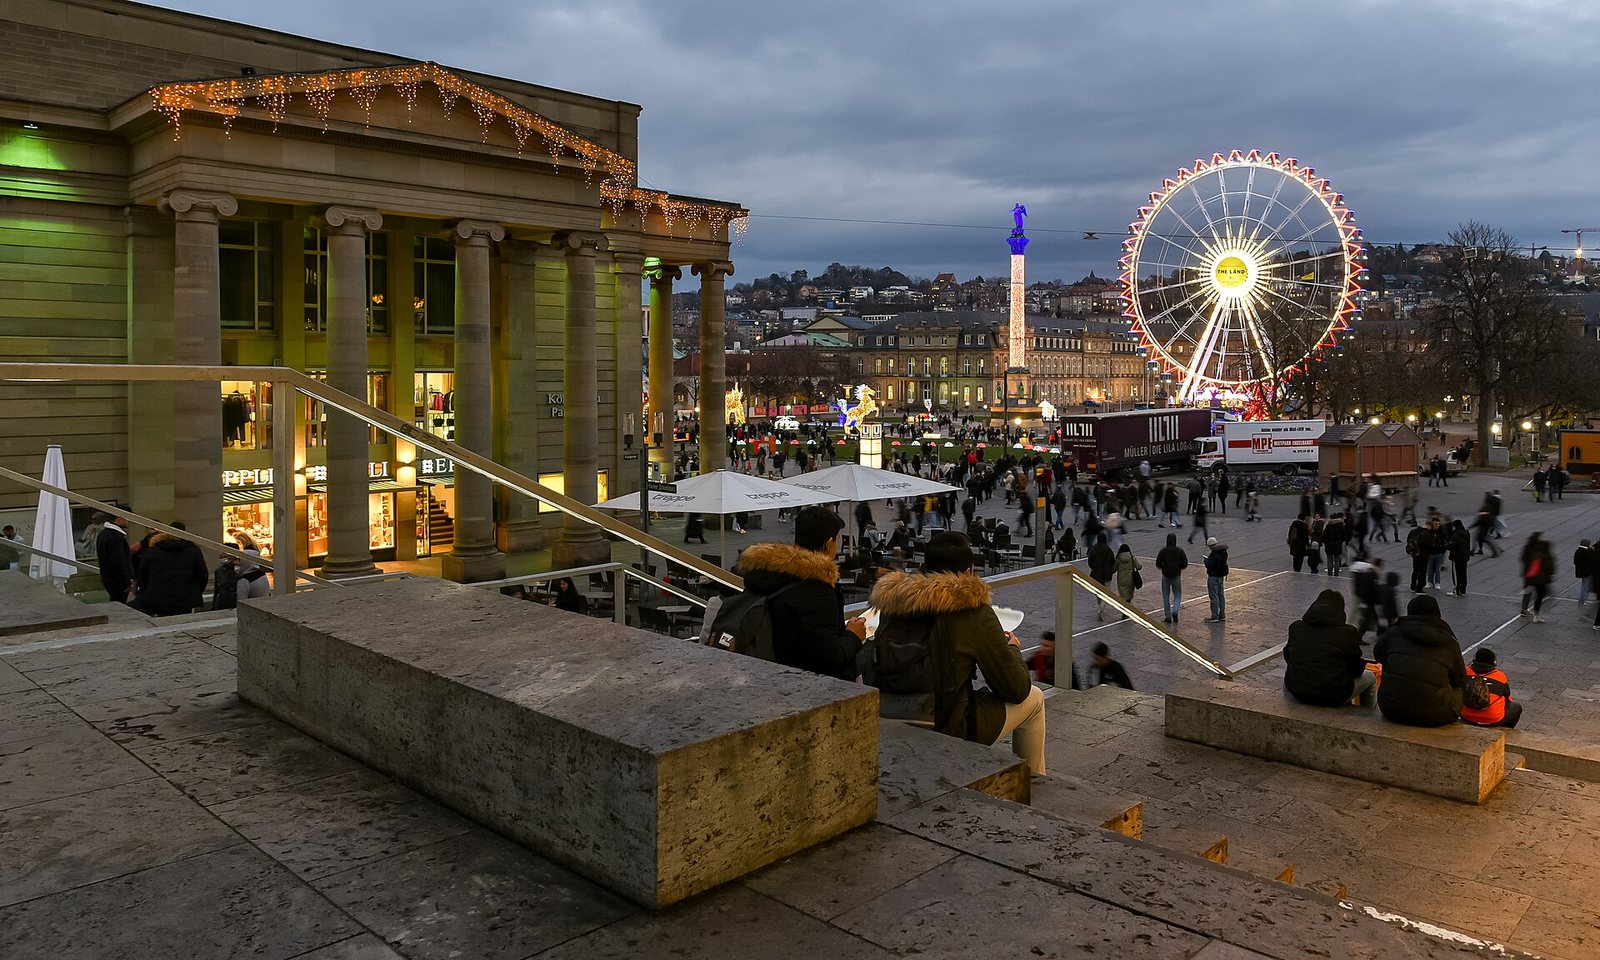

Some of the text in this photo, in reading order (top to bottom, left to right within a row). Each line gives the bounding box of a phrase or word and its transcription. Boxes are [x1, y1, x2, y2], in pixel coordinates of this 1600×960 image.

[1124, 446, 1149, 458] MÜLLER
[1152, 444, 1163, 455] DIE
[1163, 443, 1176, 454] LILA
[1252, 437, 1272, 450] MPE
[223, 467, 273, 487] PPLI
